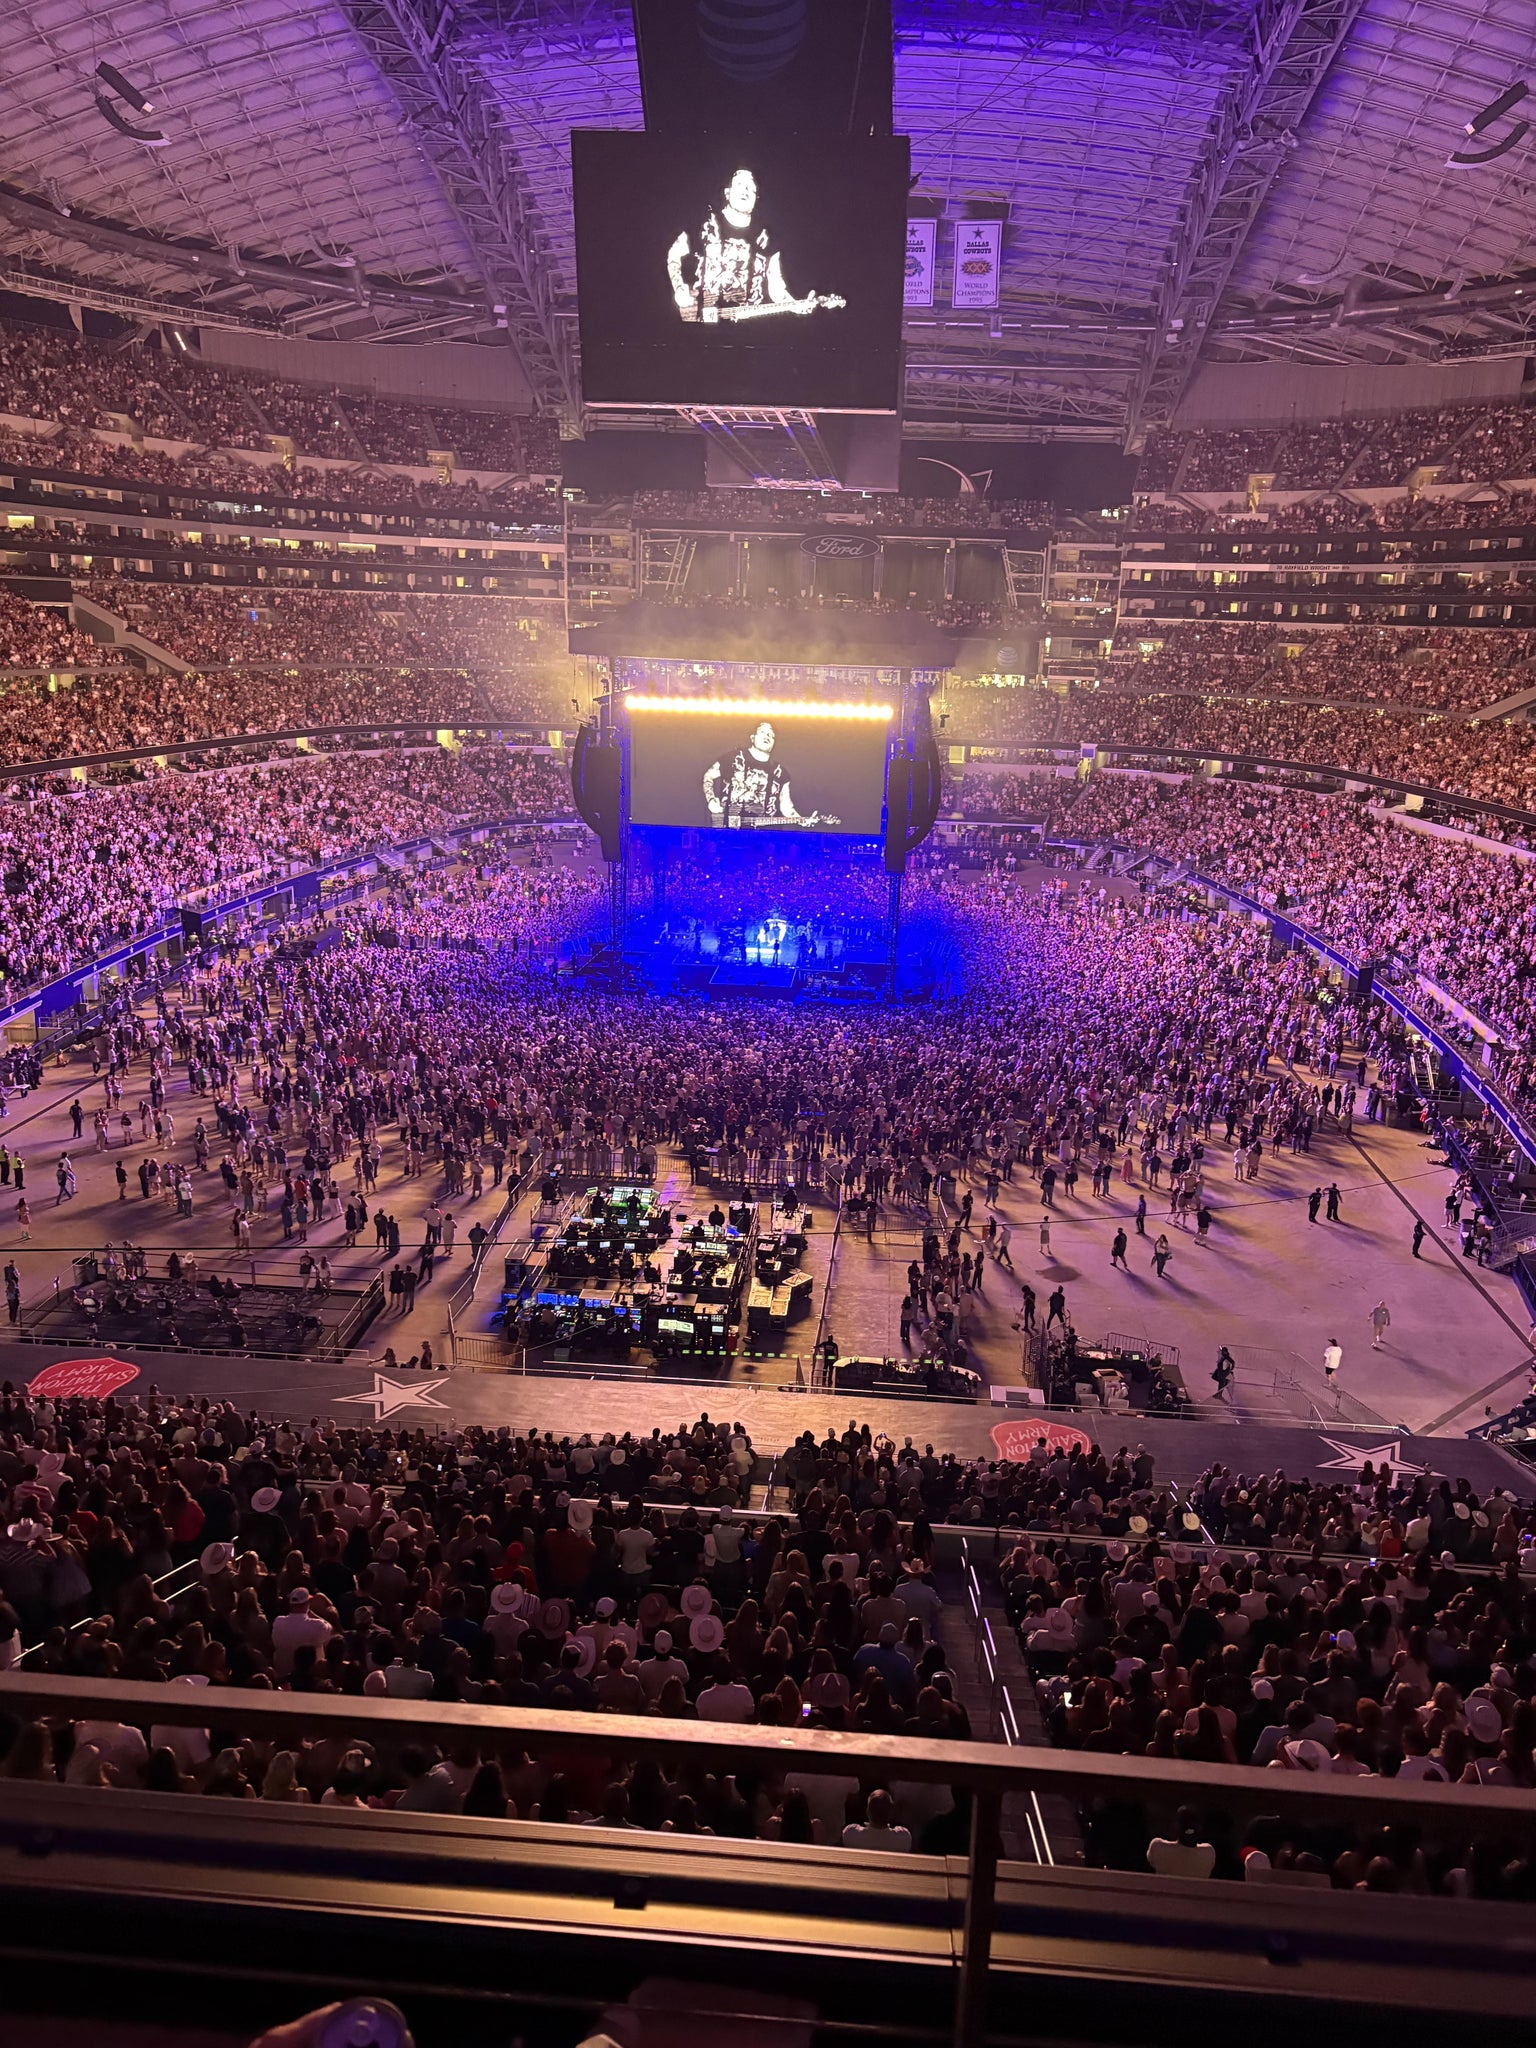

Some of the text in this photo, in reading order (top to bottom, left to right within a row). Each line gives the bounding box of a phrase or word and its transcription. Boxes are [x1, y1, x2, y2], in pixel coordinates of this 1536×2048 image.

[815, 537, 865, 555] Ford
[46, 1362, 116, 1380] ARMY
[30, 1369, 136, 1392] SALVATION
[60, 1383, 103, 1397] THE
[1006, 1424, 1051, 1445] ARMY
